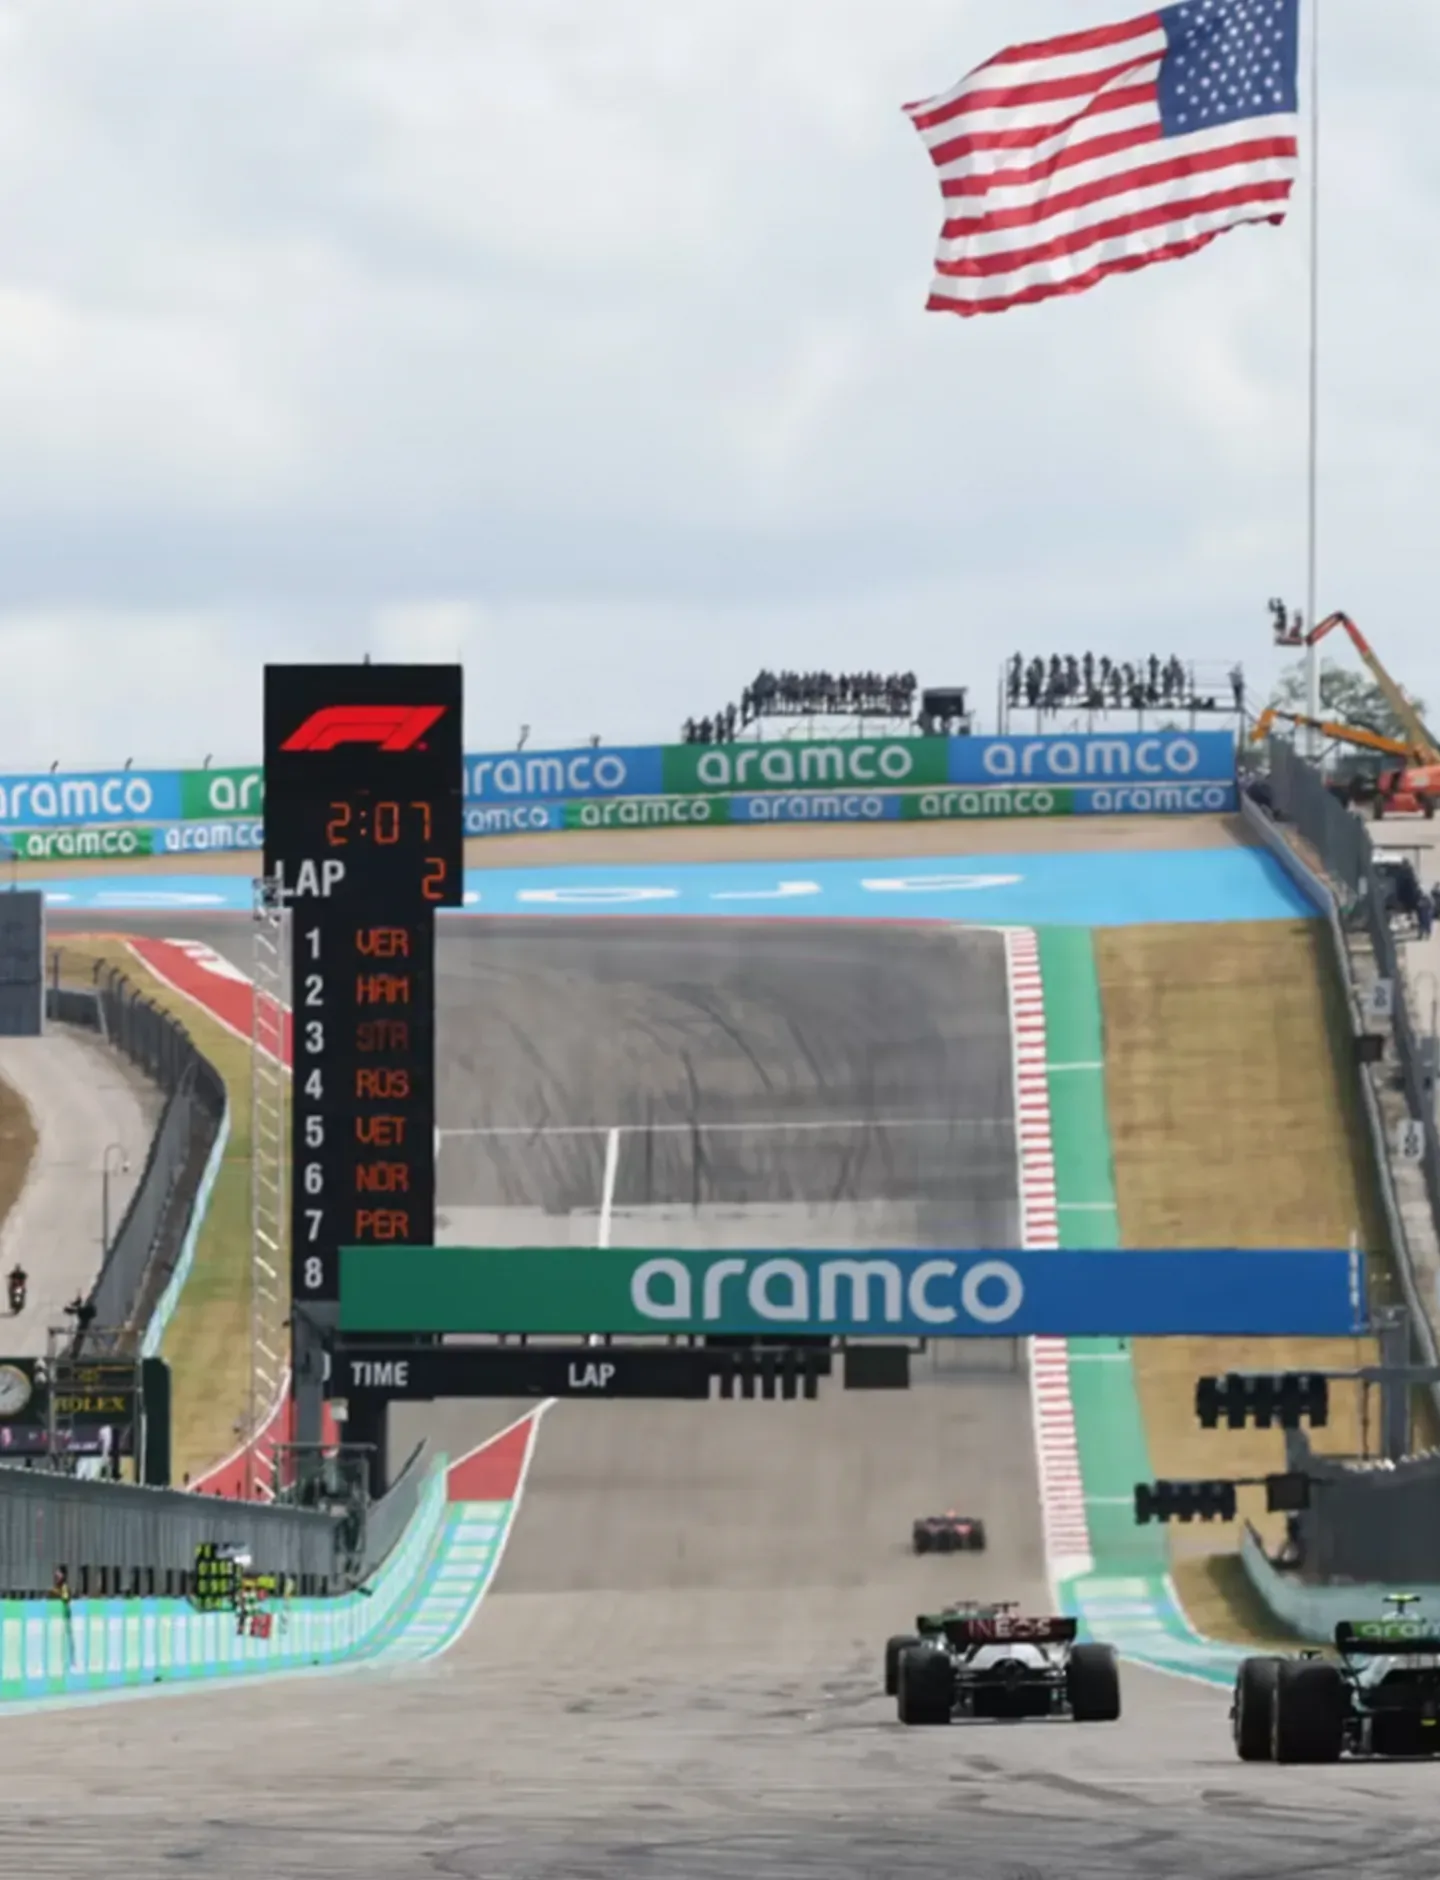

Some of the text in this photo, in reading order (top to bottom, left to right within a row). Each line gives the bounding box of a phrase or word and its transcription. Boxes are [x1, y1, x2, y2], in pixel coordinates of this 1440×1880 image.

[697, 744, 913, 785] aramco
[982, 738, 1199, 776] aramco
[464, 755, 627, 796] ramco
[0, 777, 153, 819] ramco
[208, 774, 264, 811] ar
[748, 795, 883, 819] aramco
[919, 790, 1054, 816] aramco
[1091, 785, 1226, 812] aramco
[326, 801, 431, 846] 2:07
[464, 805, 549, 832] amco
[579, 798, 711, 827] aramco
[26, 831, 137, 857] aramco
[275, 859, 346, 898] LAP
[421, 857, 447, 899] 2
[304, 927, 410, 960] 1 VER
[304, 974, 410, 1007] 2 HAM
[304, 1020, 324, 1054] 3
[304, 1068, 410, 1100] 4 RUS
[304, 1115, 410, 1148] 5 VET
[304, 1162, 410, 1195] 6 NOR
[304, 1209, 410, 1242] 7 PER
[304, 1256, 323, 1290] 8
[630, 1258, 1025, 1323] aramco
[349, 1360, 410, 1388] TIME
[567, 1362, 615, 1388] LAP
[968, 1618, 1051, 1639] INEOS
